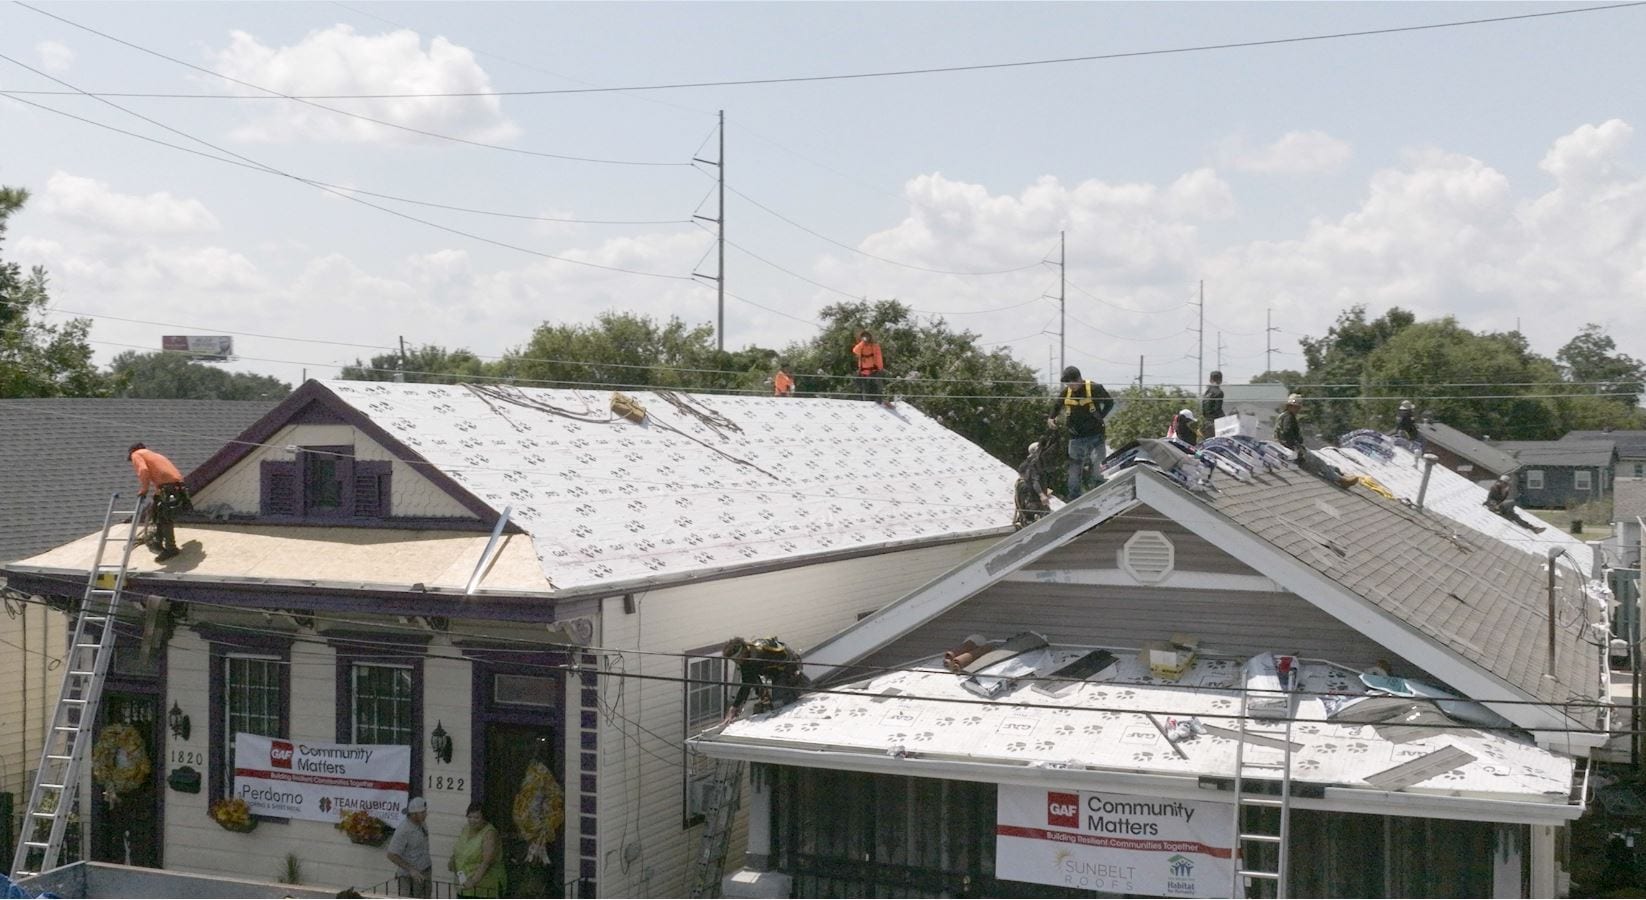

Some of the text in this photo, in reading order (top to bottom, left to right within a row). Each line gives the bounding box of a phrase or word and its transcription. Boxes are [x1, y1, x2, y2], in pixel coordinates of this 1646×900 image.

[171, 750, 203, 765] 1820
[271, 748, 293, 760] GAF
[299, 744, 373, 764] Community
[297, 758, 346, 774] Matters
[428, 775, 464, 791] 1822
[242, 784, 303, 804] Perdomo
[334, 797, 400, 812] TEAM RUBICON
[1049, 803, 1077, 817] GAF
[1087, 796, 1195, 823] Community
[1087, 815, 1159, 836] Matters
[1046, 831, 1199, 853] Building Resilient Communities Together
[1065, 860, 1136, 880] SUNBELT
[1064, 874, 1134, 892] ROOFS
